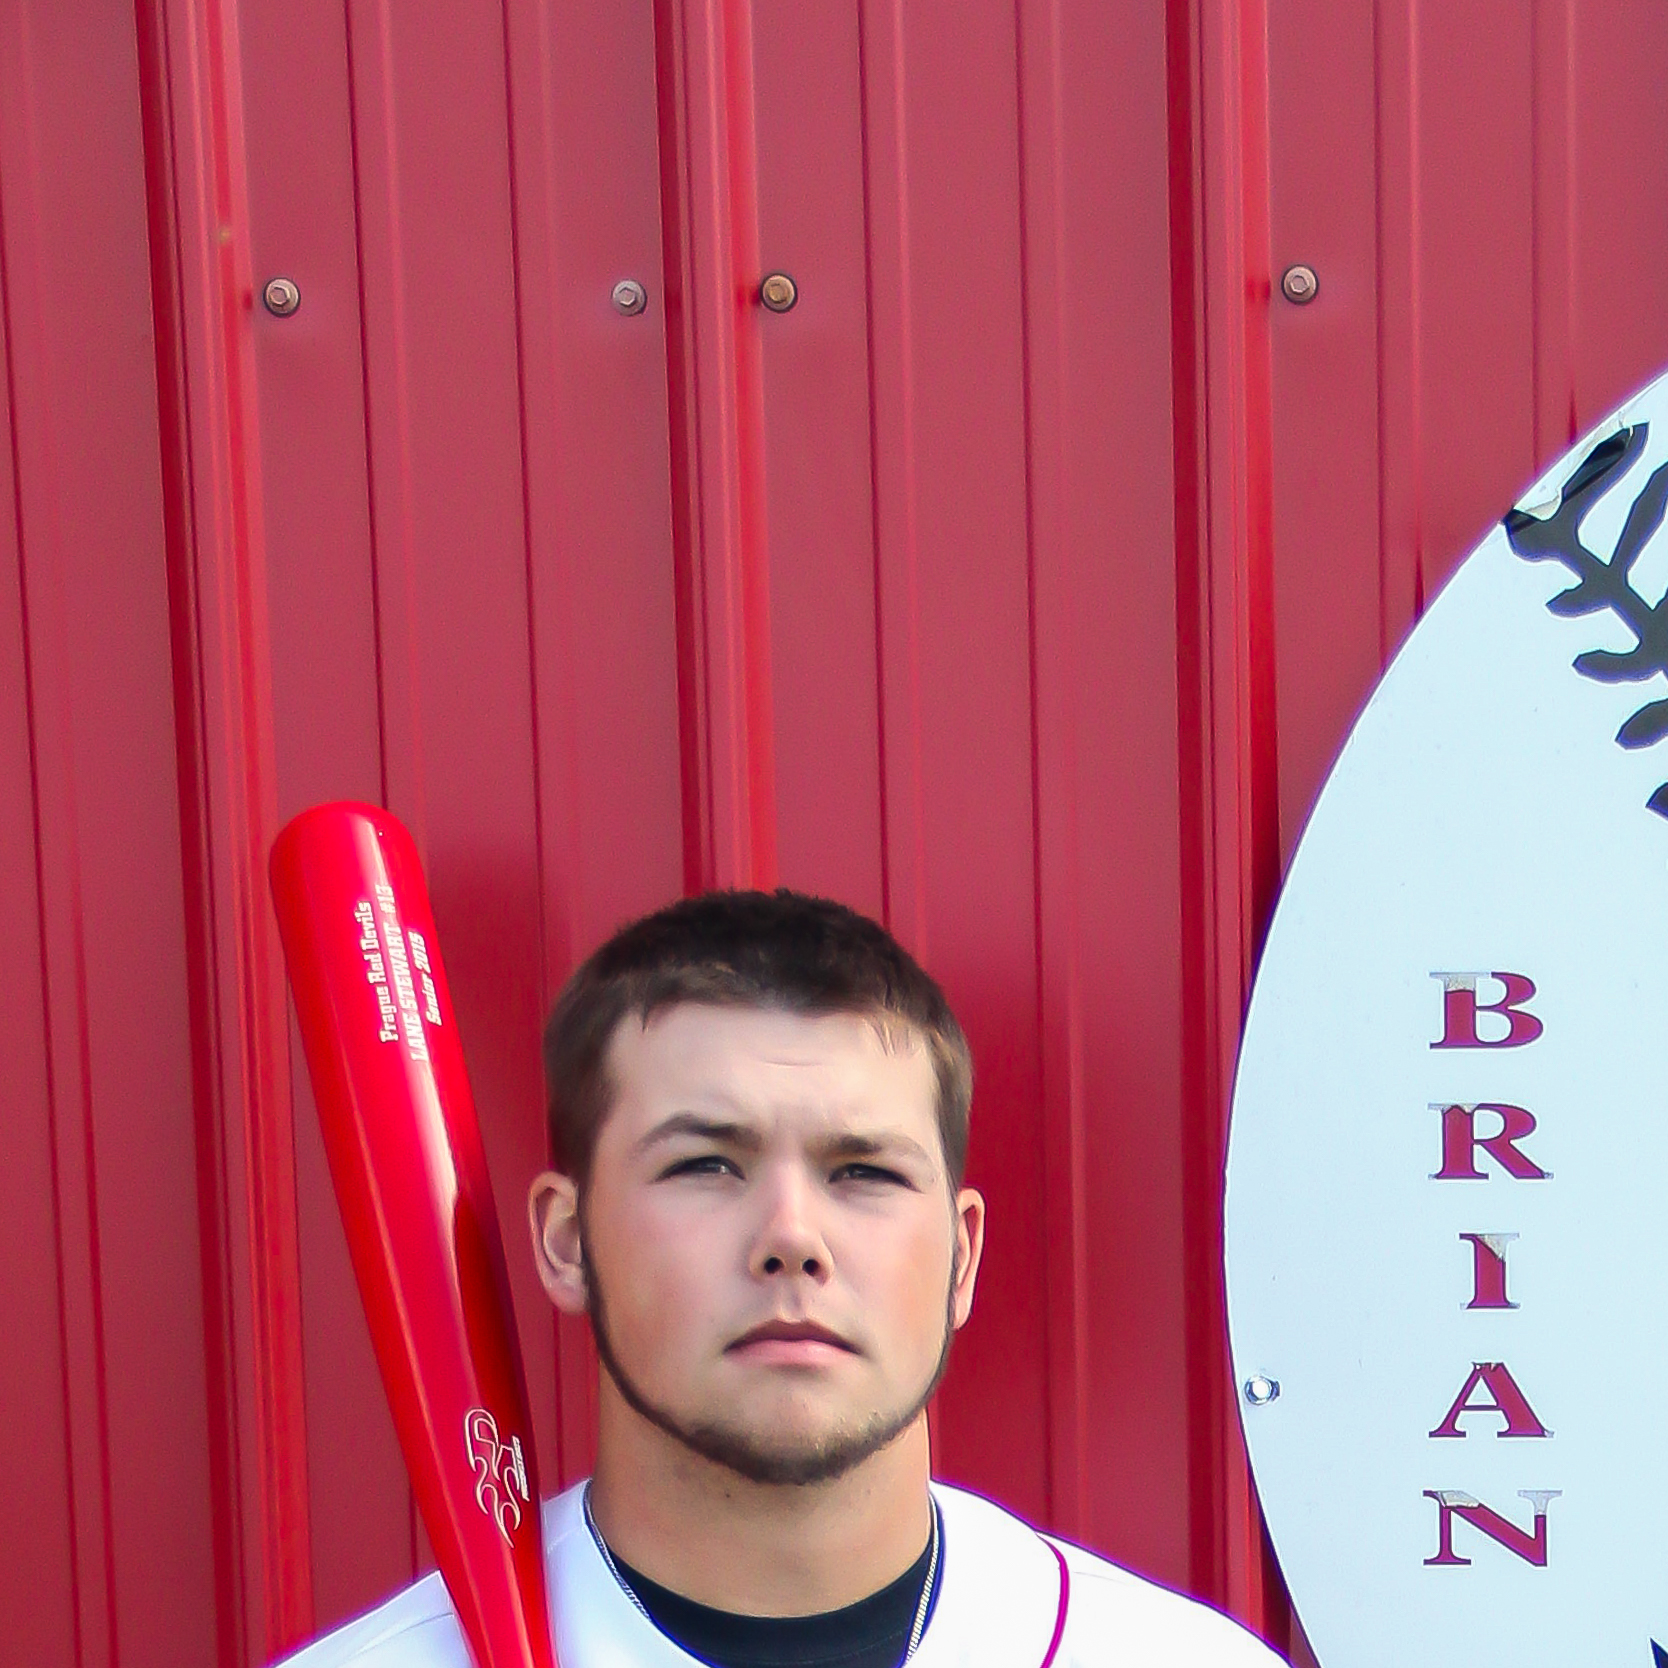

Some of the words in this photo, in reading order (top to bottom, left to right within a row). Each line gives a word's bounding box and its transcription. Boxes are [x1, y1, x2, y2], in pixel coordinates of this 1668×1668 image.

[354, 901, 379, 951] Devils
[363, 953, 386, 984] Red
[383, 922, 419, 1011] STEWART
[408, 931, 431, 974] 2015
[376, 985, 399, 1043] Prague
[422, 973, 442, 1026] Senior
[402, 1012, 429, 1063] LANE
[1423, 971, 1563, 1567] BRIAN
